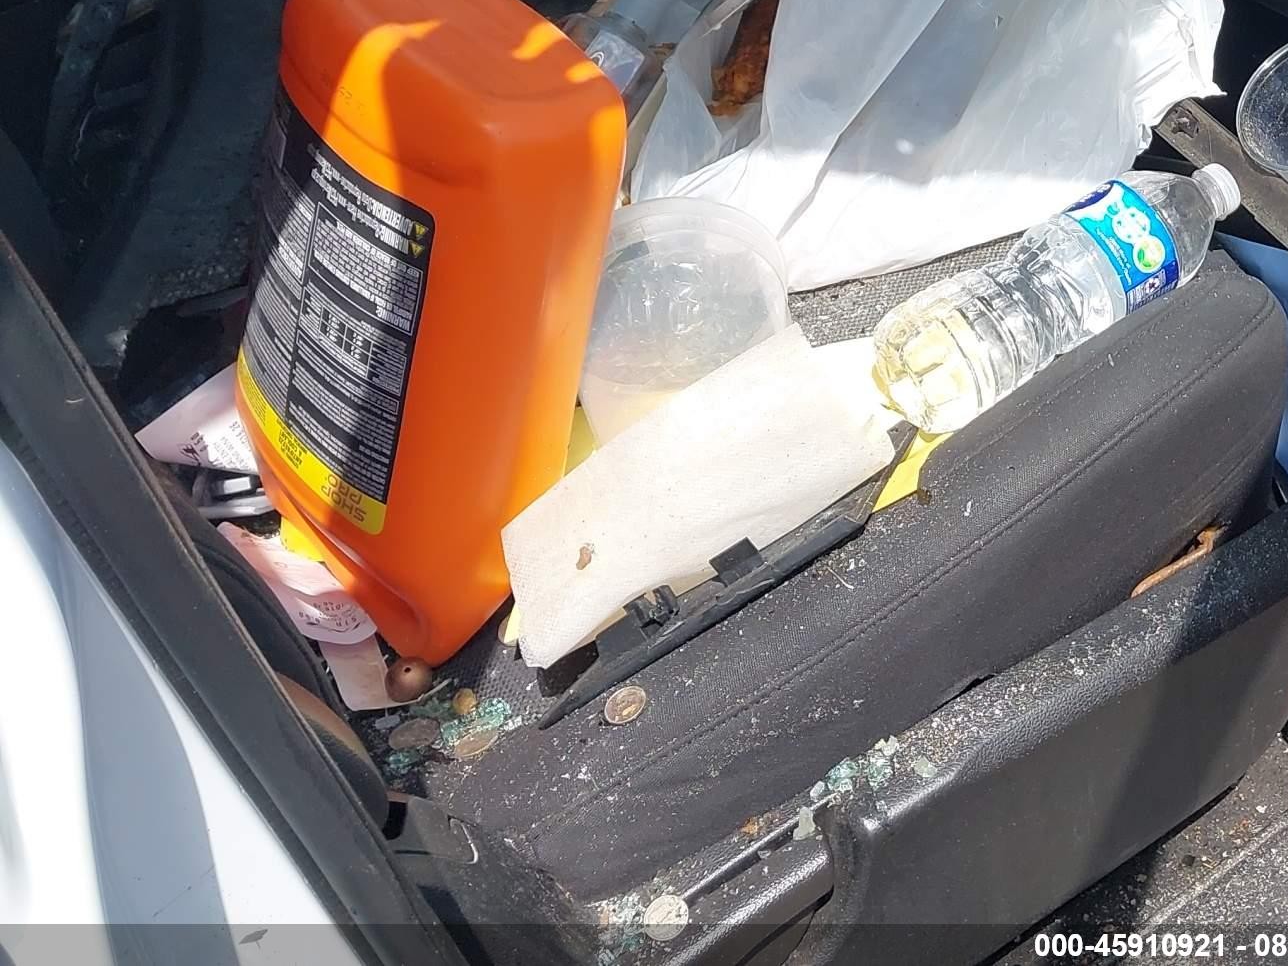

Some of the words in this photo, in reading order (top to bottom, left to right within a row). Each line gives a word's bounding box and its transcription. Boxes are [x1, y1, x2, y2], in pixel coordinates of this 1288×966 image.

[376, 305, 411, 332] WARNING:
[320, 484, 368, 523] SHOP
[327, 473, 363, 506] PRO
